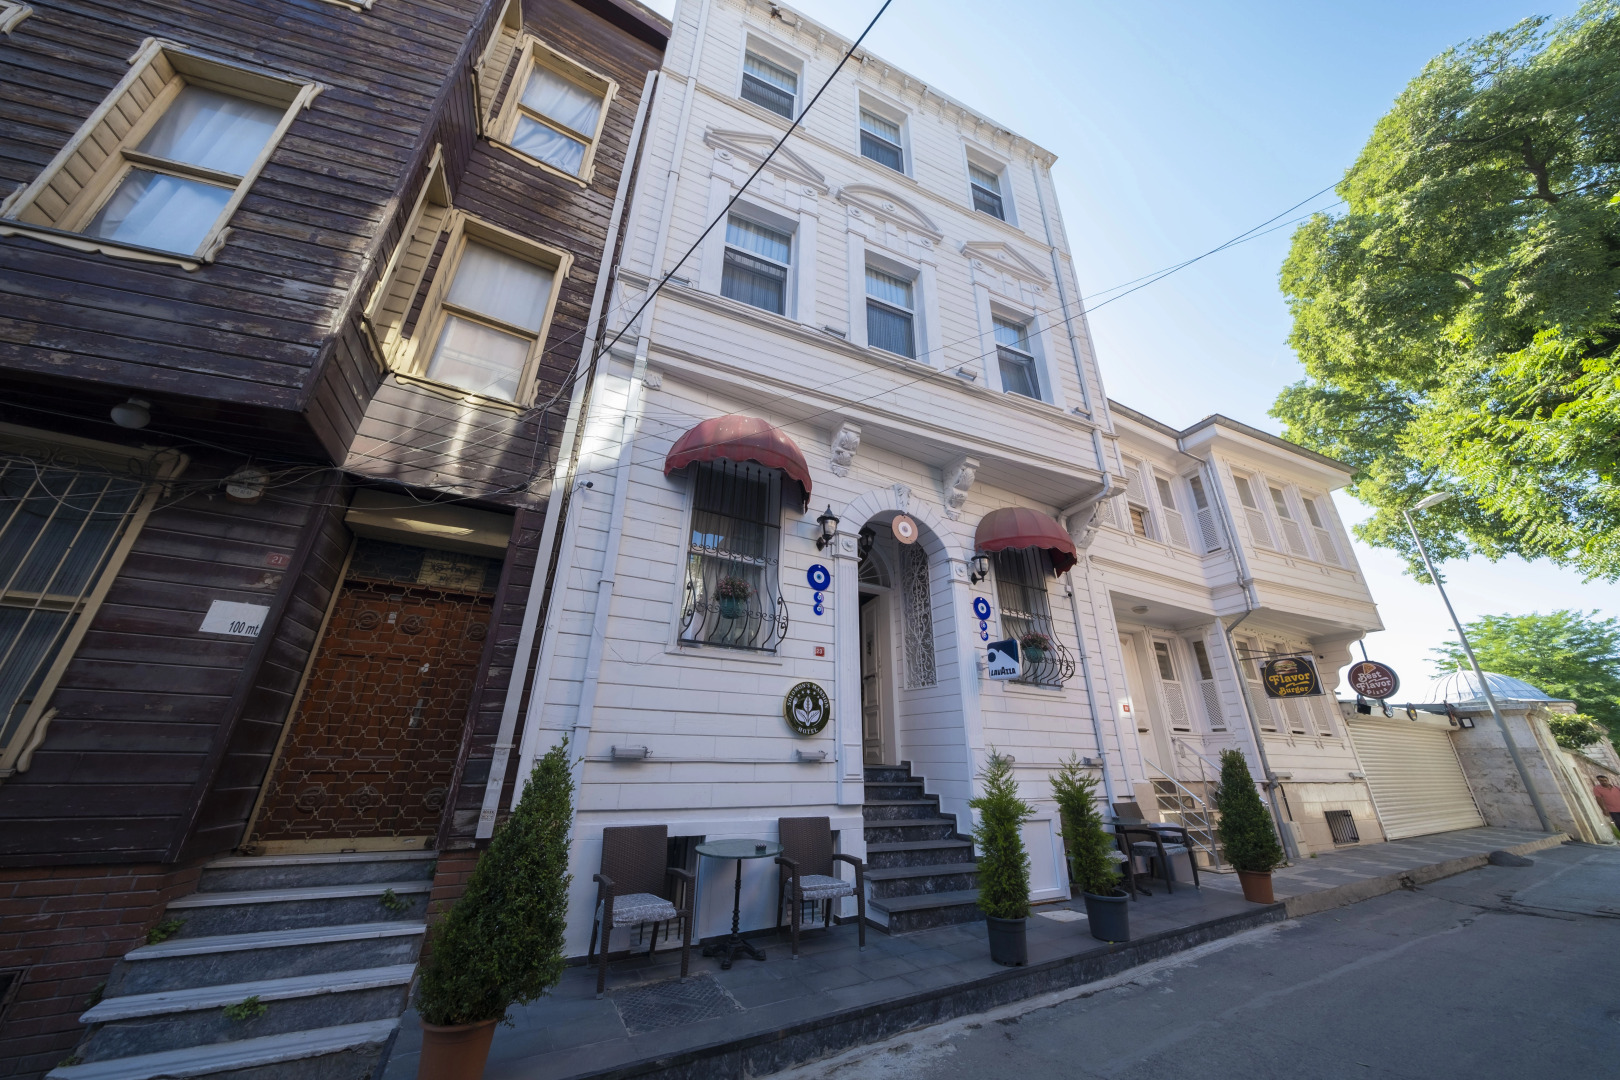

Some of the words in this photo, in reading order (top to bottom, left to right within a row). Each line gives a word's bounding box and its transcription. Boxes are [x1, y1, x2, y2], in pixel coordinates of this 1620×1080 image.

[271, 555, 283, 564] 21
[228, 620, 246, 633] 100
[990, 666, 1017, 677] LAVAZZA
[1357, 671, 1382, 683] Best
[1268, 672, 1310, 686] Flavor
[1278, 686, 1309, 696] Burger
[1356, 680, 1392, 691] Flavor
[1366, 687, 1388, 695] Pizza
[787, 683, 811, 706] SOLOMON'S
[812, 684, 829, 709] MANSION
[797, 726, 819, 735] HOTEL
